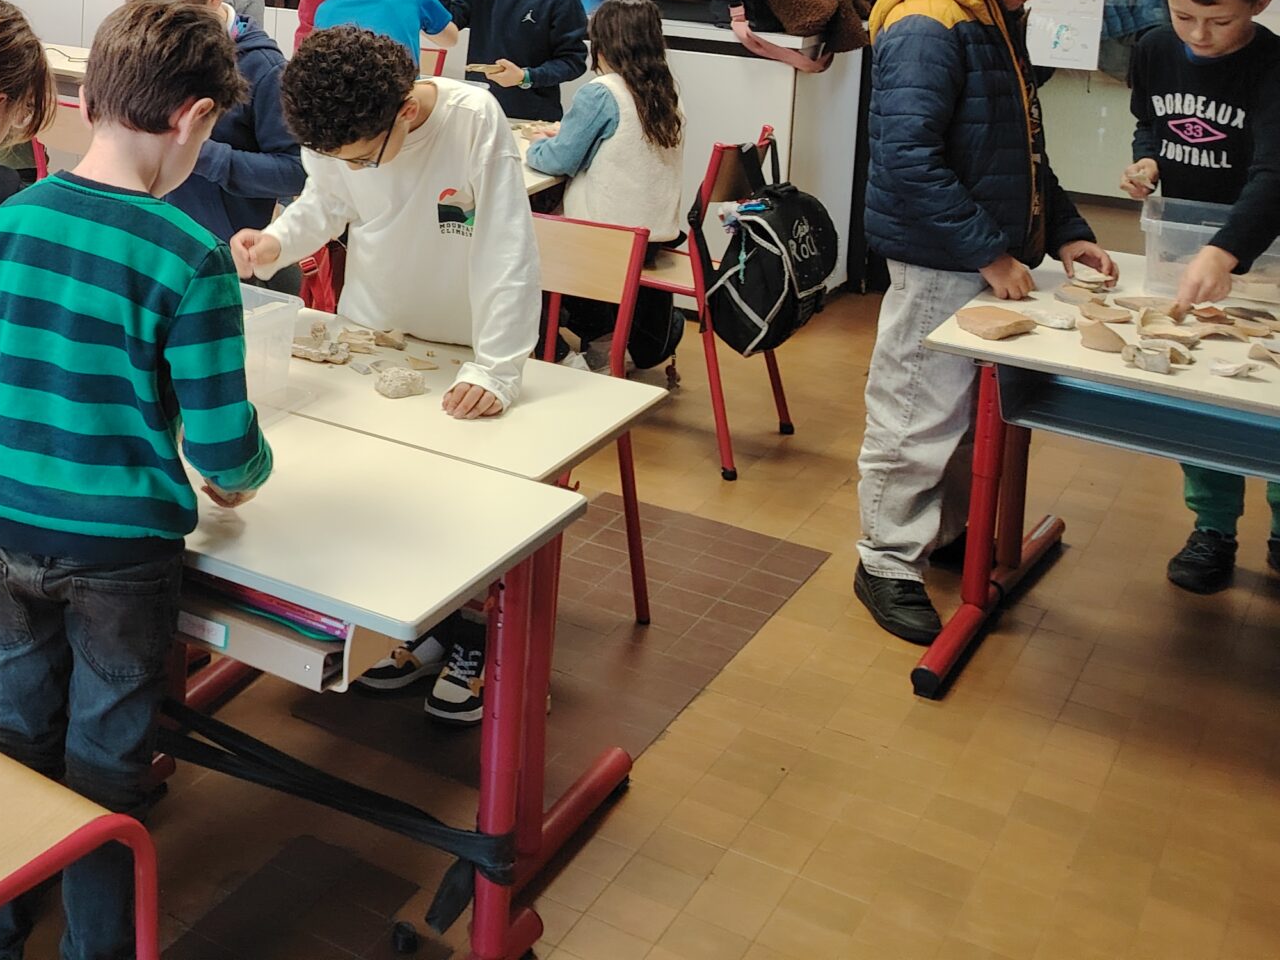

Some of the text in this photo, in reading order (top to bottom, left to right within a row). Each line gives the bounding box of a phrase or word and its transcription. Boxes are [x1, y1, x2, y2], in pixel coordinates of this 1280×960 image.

[1151, 93, 1246, 129] BORDEAUX
[1183, 123, 1203, 138] 33
[1160, 139, 1232, 168] FOOTBALL
